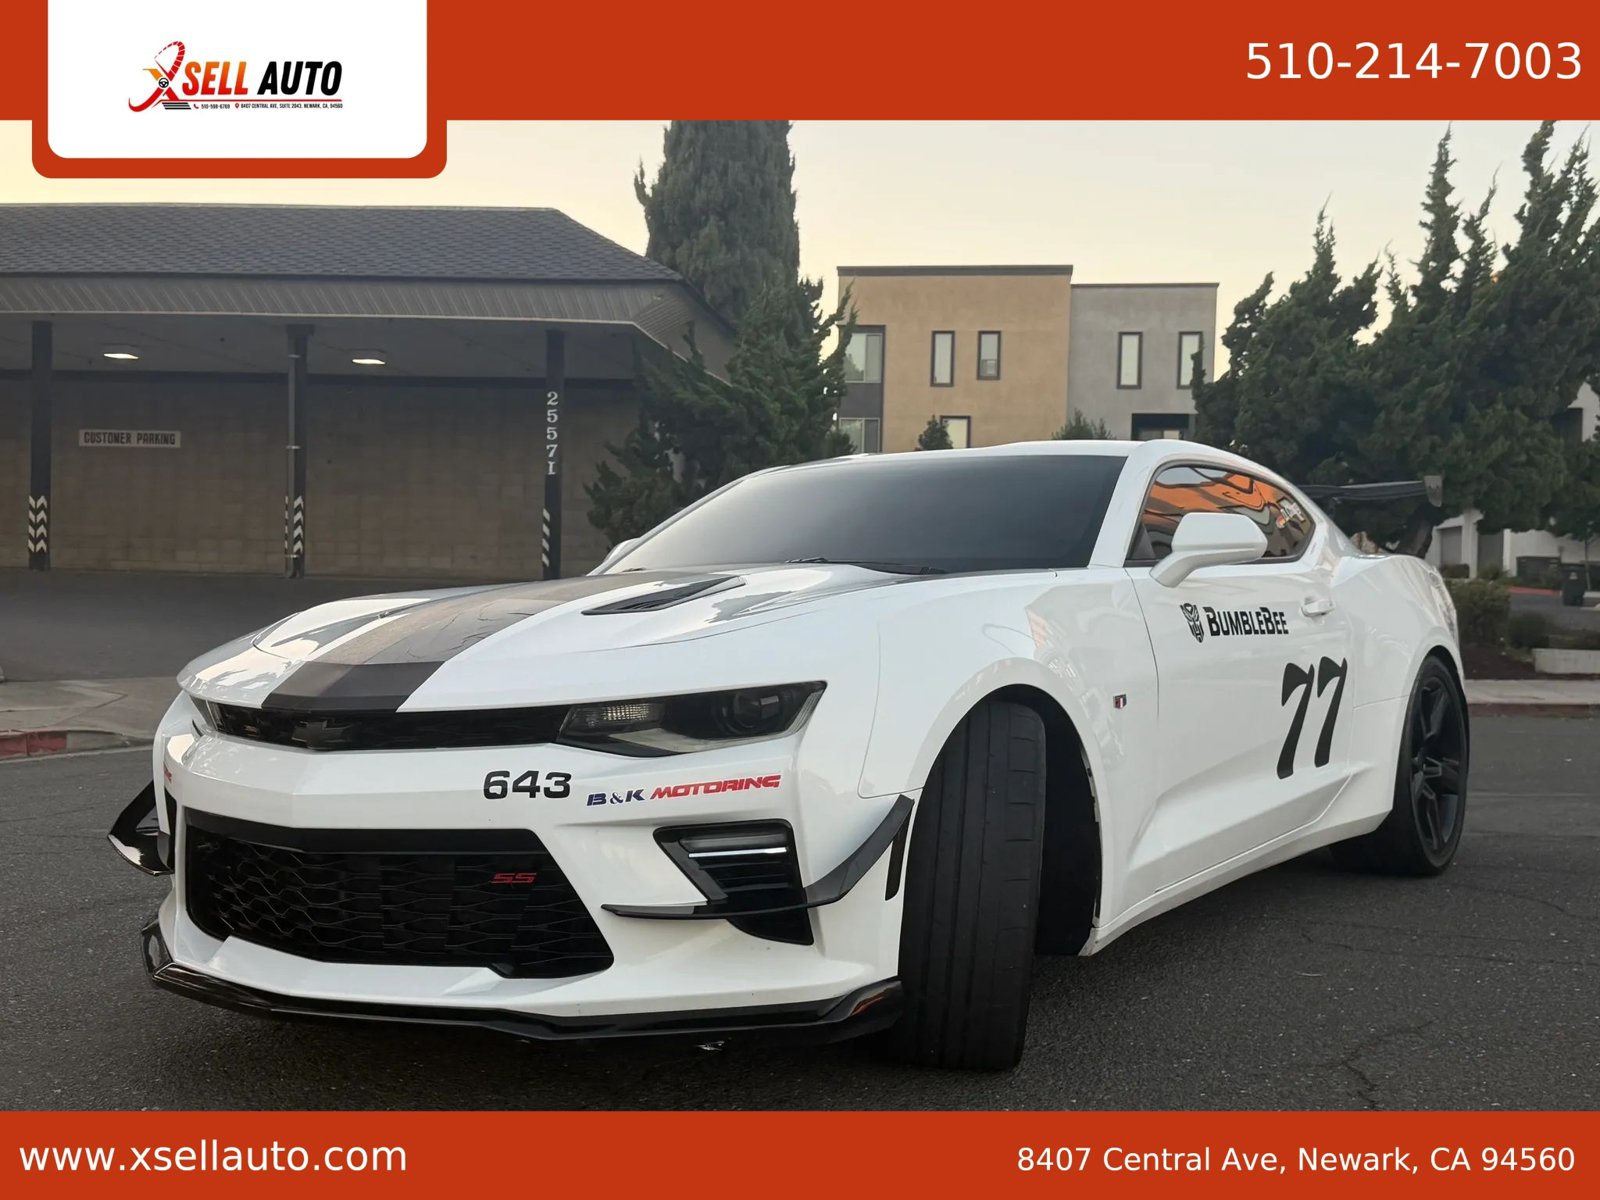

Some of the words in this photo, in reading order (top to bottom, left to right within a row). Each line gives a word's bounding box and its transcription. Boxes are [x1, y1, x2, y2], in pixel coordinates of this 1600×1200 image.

[136, 432, 176, 445] PARKING
[546, 391, 559, 475] 25571
[1277, 656, 1348, 780] 77
[483, 770, 572, 800] 643
[650, 774, 782, 800] MOTORING
[491, 872, 537, 884] SS
